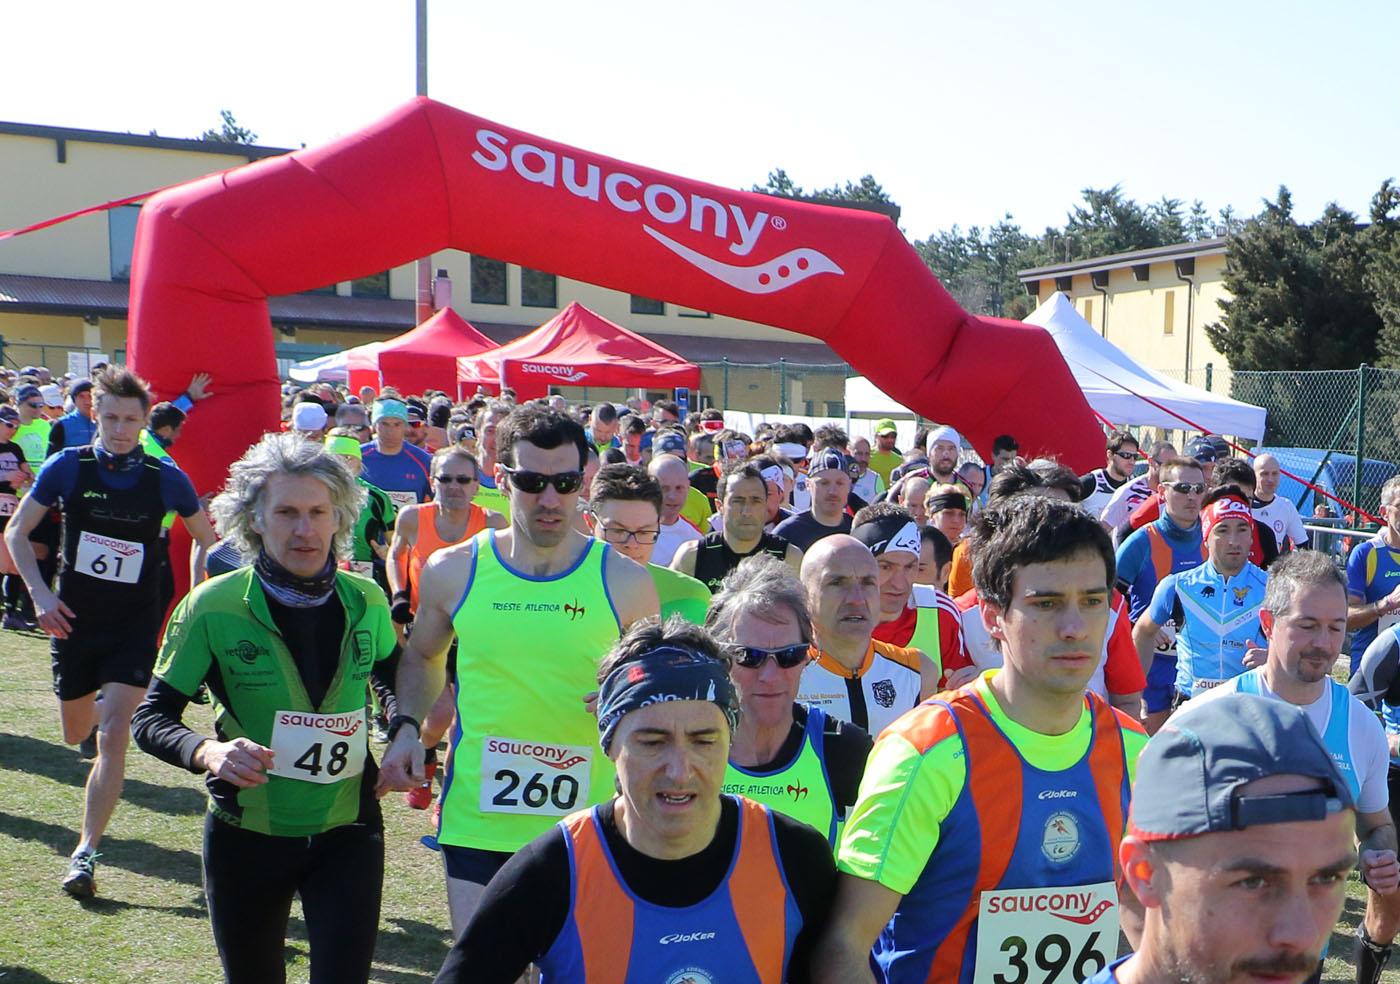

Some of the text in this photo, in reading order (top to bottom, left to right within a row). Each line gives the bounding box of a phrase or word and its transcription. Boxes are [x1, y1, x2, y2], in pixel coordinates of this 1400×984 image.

[471, 128, 769, 256] saucony
[521, 363, 574, 376] saucony
[83, 534, 131, 550] saucony
[91, 553, 123, 578] 61
[492, 602, 560, 612] TRIESTE ATLETICA
[280, 714, 354, 731] saucony
[294, 741, 349, 776] 48
[488, 740, 568, 761] saucony
[492, 769, 579, 810] 260
[747, 785, 784, 795] ATLETICA
[987, 892, 1092, 914] saucony
